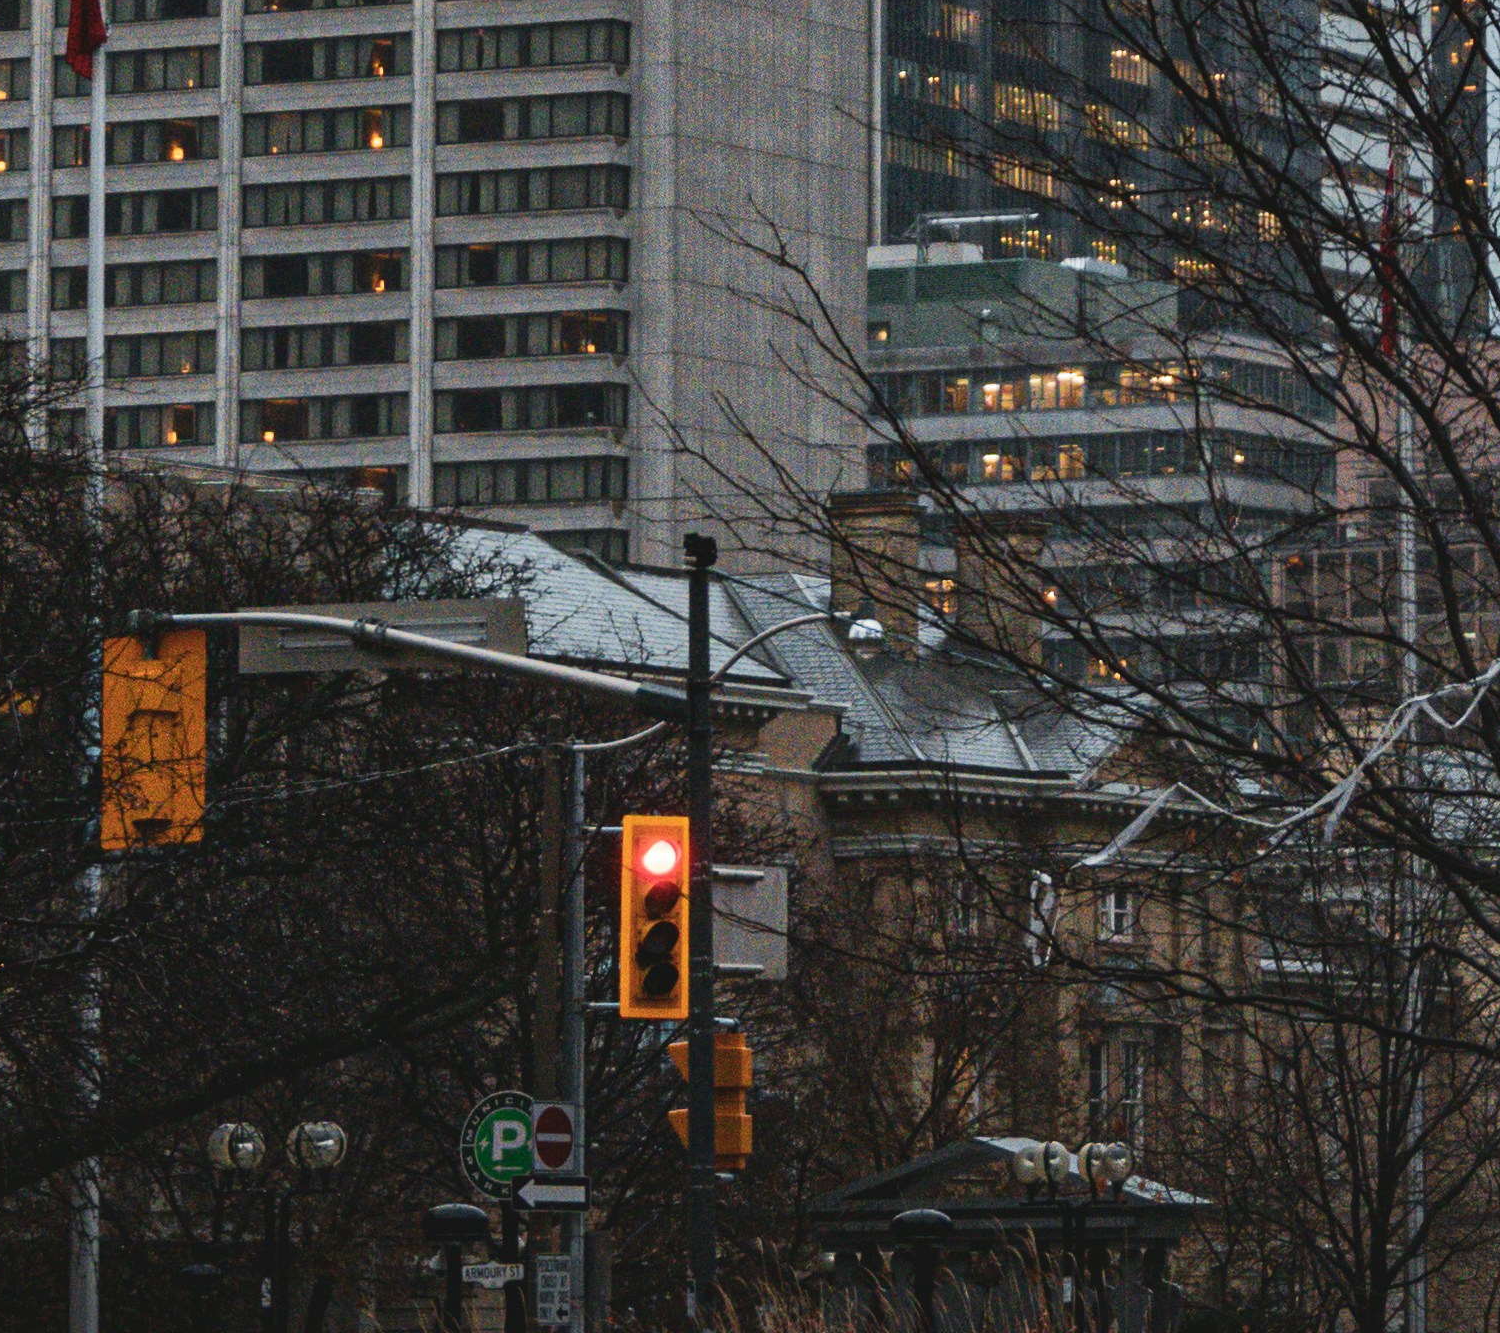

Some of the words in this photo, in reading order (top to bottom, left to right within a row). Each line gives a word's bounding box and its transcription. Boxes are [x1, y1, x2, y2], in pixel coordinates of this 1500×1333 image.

[492, 1119, 527, 1162] P
[465, 1265, 507, 1280] ARMOURY
[509, 1265, 521, 1278] ST
